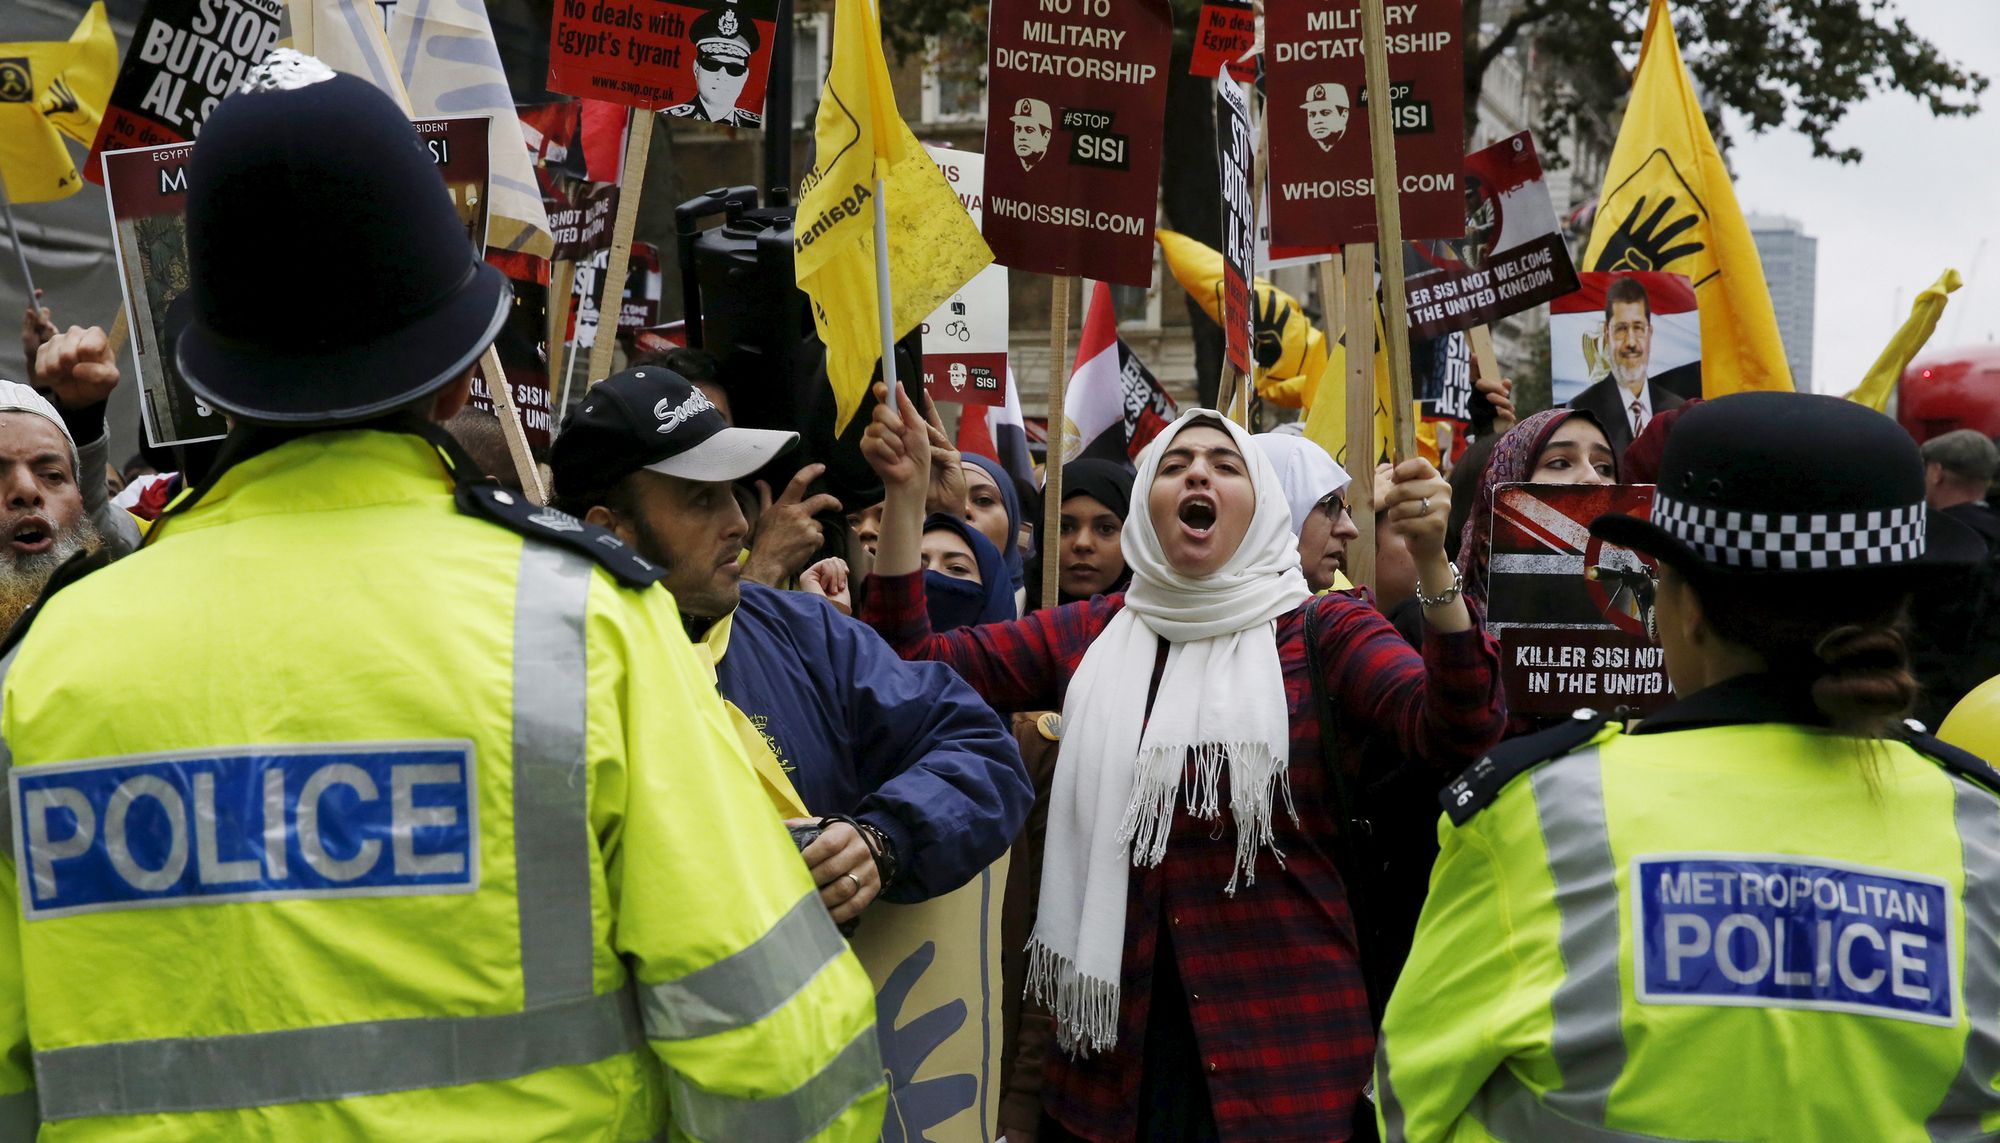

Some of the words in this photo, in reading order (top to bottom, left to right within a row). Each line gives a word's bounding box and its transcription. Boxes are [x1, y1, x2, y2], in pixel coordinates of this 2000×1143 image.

[563, 0, 585, 19] No
[592, 0, 643, 30] deals
[648, 11, 685, 38] with
[1039, 0, 1071, 14] NO
[1307, 4, 1418, 31] MILIRY
[192, 0, 280, 64] STOP
[558, 22, 621, 57] Egypt's
[628, 36, 681, 69] tyrant
[1023, 20, 1126, 50] MILITARY
[1276, 31, 1451, 62] DICTATRSHIP
[140, 18, 250, 100] BUTCH
[996, 48, 1156, 84] DICTATORSHIP
[591, 75, 675, 100] www.swp.org.uk
[1063, 112, 1110, 129] #STOP
[1394, 105, 1427, 128] ISI
[1077, 134, 1124, 163] SISI
[1282, 174, 1455, 200] WHOISSI.COM
[991, 196, 1145, 236] WHOISSISI.COM
[1433, 281, 1459, 301] SISI
[1461, 270, 1491, 292] NOT
[1493, 247, 1553, 281] WELCOME
[1413, 302, 1445, 325] THE
[1445, 288, 1497, 316] UNITED
[1498, 268, 1554, 302] KINGDOM
[517, 384, 542, 407] SISI
[976, 377, 997, 389] SISI
[1516, 646, 1586, 667] KILLER
[1592, 647, 1629, 668] SISI
[1635, 648, 1665, 669] NOT
[1529, 672, 1549, 694] IN
[1557, 673, 1597, 694] THE
[1604, 672, 1662, 695] UNITED
[26, 764, 465, 900] POLICE
[1661, 872, 1930, 926] METROPOLITAN
[1664, 914, 1932, 1001] POLICE
